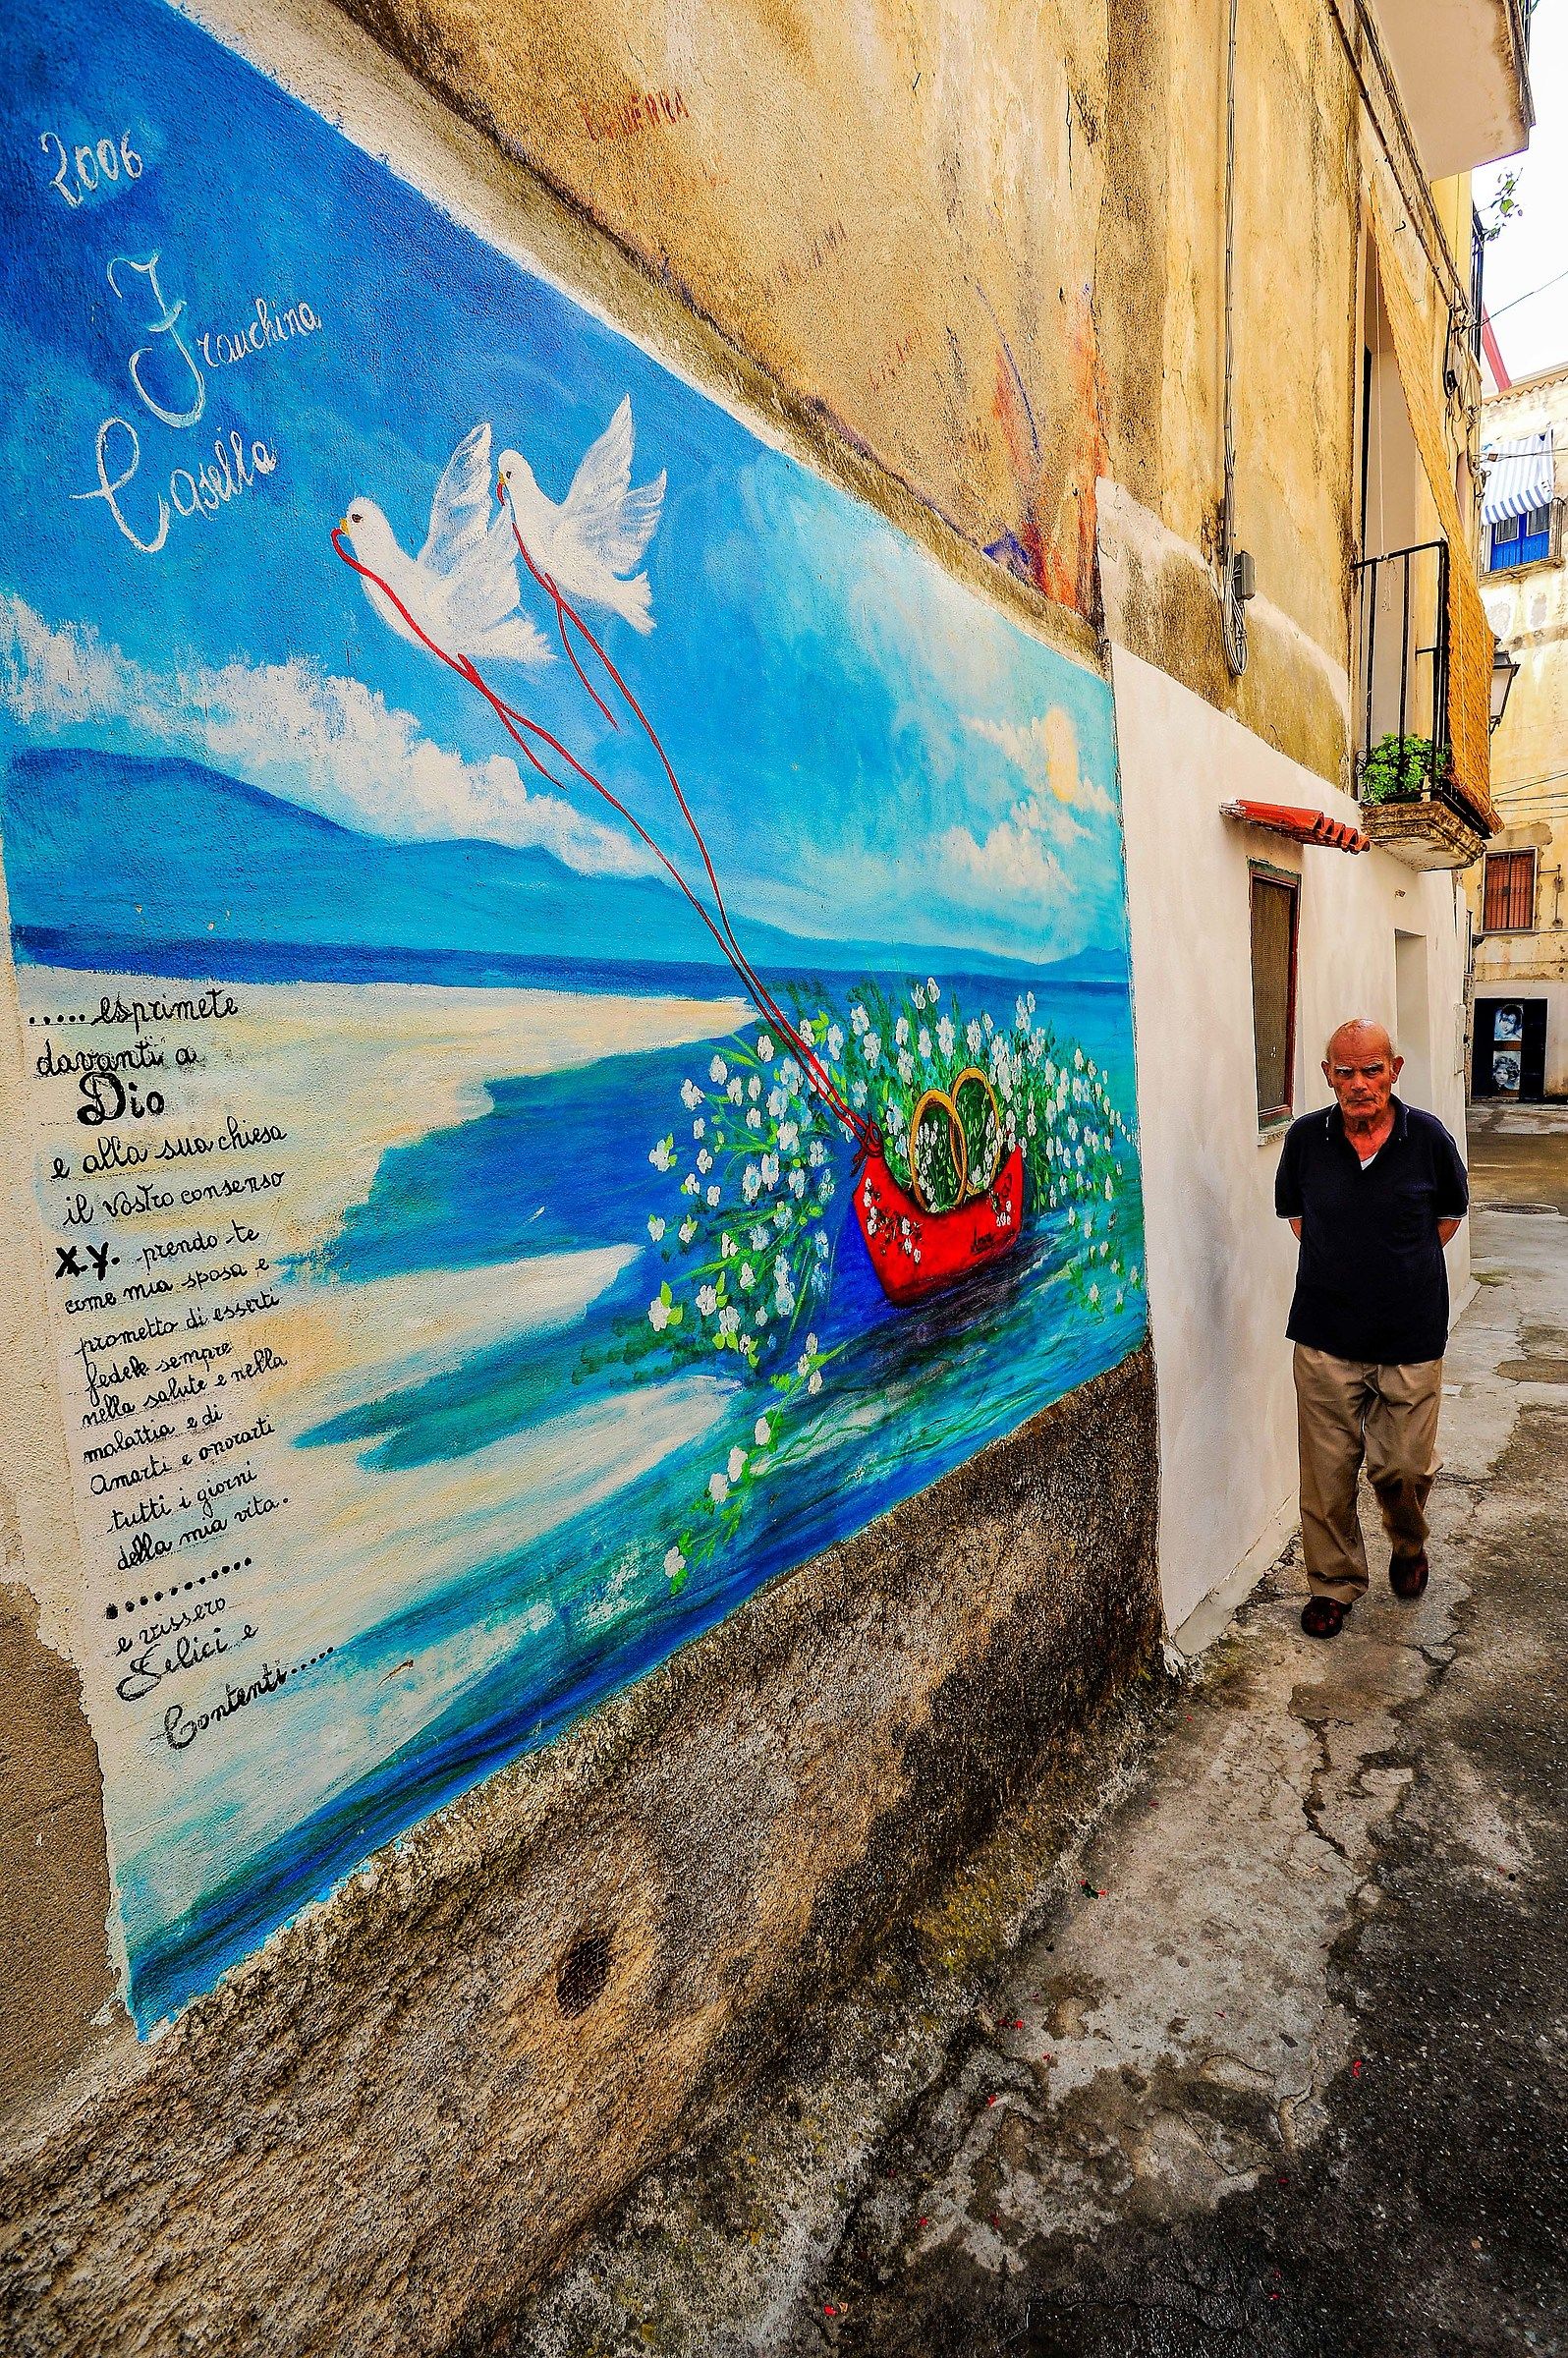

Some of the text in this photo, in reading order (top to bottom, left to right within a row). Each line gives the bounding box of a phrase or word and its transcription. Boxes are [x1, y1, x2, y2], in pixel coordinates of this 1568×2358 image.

[40, 130, 143, 207] 2006
[69, 417, 277, 553] Casella
[36, 1037, 197, 1077] davanti a
[77, 1072, 165, 1125] Dio
[51, 1116, 288, 1179] e alla sua chiesa
[63, 1171, 285, 1226] il vostro consenso
[137, 1231, 218, 1272] prendo
[65, 1258, 269, 1314] come mia sposa e
[75, 1287, 279, 1364] prometto di esserti
[155, 1341, 233, 1372] sempre
[83, 1347, 288, 1425] nella salute e nella
[84, 1404, 224, 1463] malattia e di
[182, 1454, 193, 1465] e
[199, 1414, 275, 1460] onorarti
[107, 1461, 257, 1533] tutti i giorni
[118, 1532, 172, 1570] della
[179, 1517, 228, 1545] mia
[115, 1598, 226, 1656] e vissero
[242, 1624, 259, 1641] e
